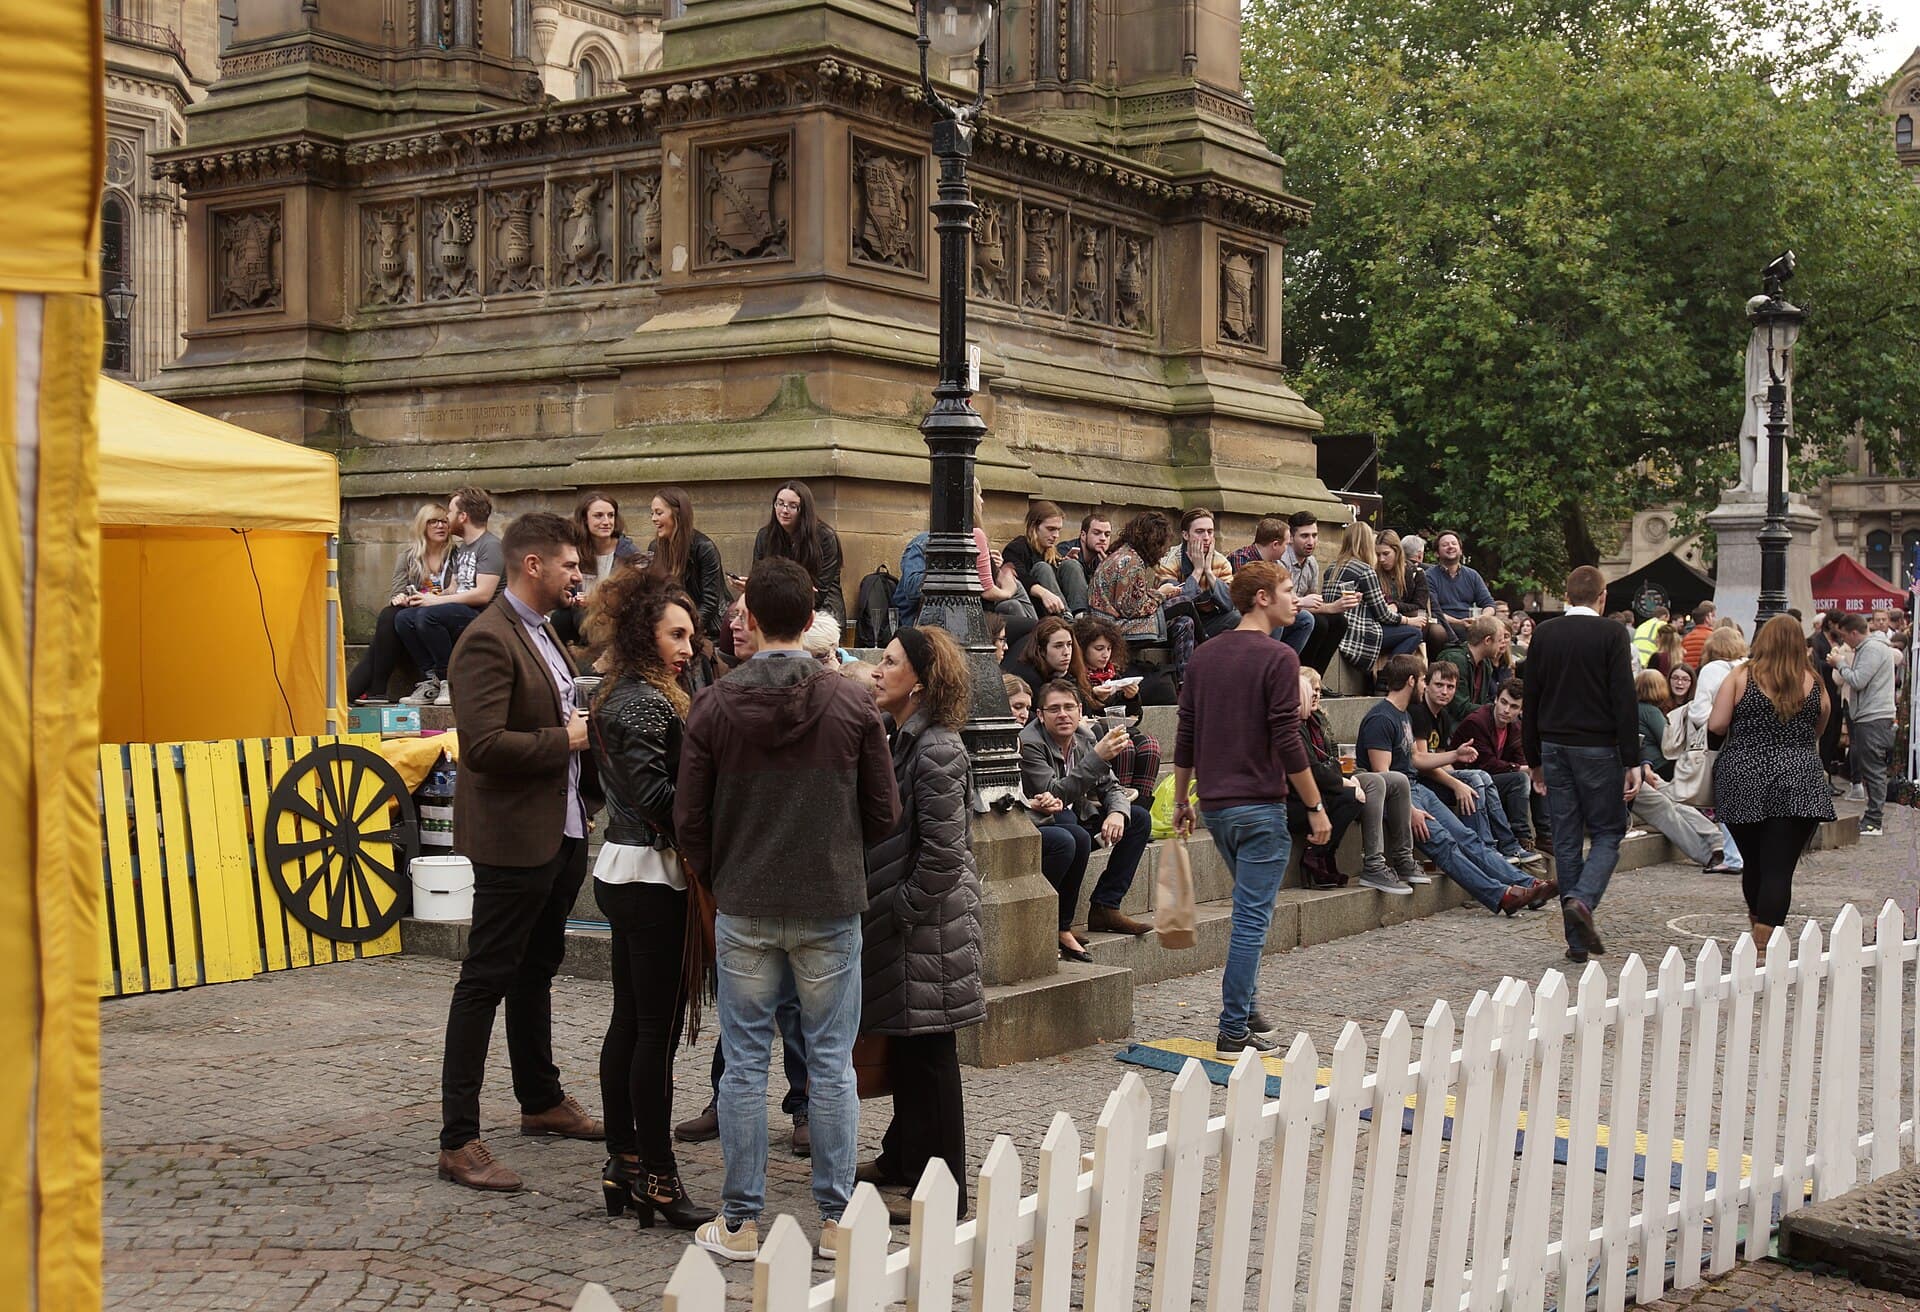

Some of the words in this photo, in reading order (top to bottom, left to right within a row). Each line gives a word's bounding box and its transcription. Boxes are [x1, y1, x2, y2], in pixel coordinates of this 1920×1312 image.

[437, 409, 448, 422] BY
[449, 408, 463, 421] THE
[519, 405, 530, 417] OF
[1813, 599, 1839, 610] RISKET
[1846, 599, 1864, 610] RIBS
[1871, 598, 1894, 609] SIDES
